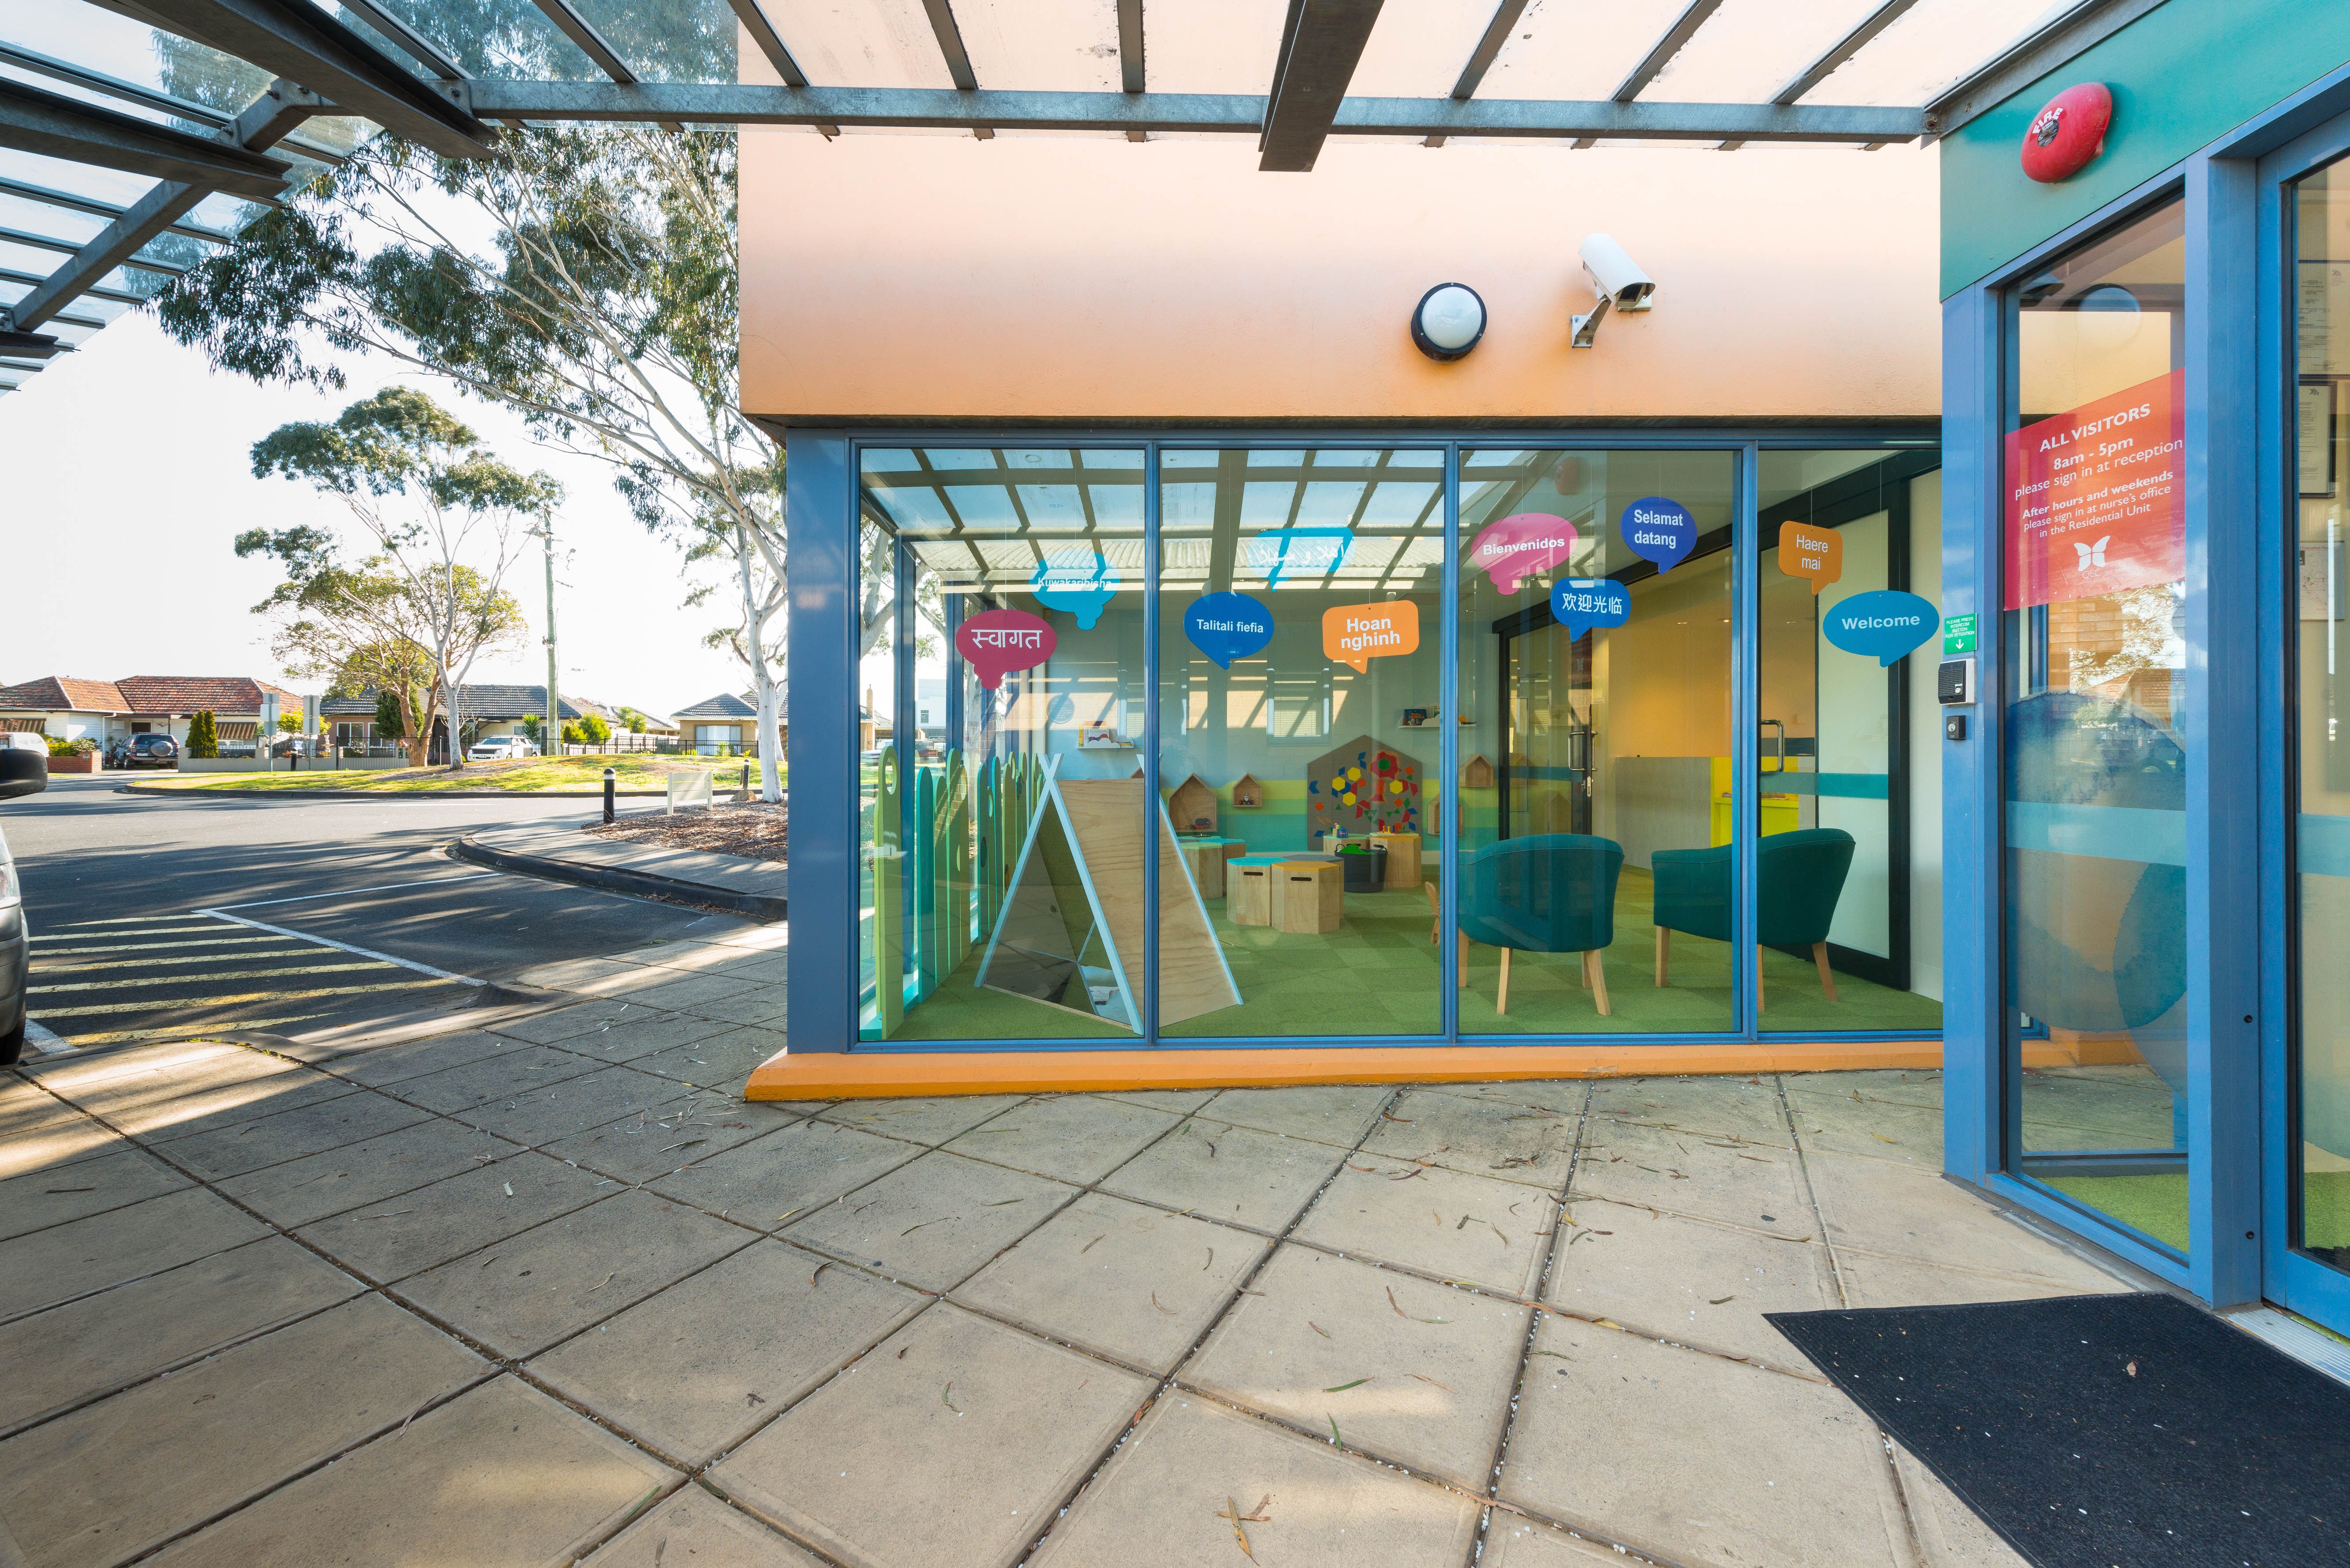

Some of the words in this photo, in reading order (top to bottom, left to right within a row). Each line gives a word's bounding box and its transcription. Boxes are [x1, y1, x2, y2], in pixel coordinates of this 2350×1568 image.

[2032, 107, 2063, 134] FIRE
[2040, 434, 2069, 452] ALL
[2071, 403, 2151, 440] VISITORS
[2054, 454, 2084, 469] 8am
[2100, 439, 2133, 458] 5pm
[2015, 480, 2050, 500] please
[2054, 472, 2077, 486] sign
[2082, 467, 2092, 477] in
[2097, 462, 2109, 473] at
[2115, 439, 2182, 467] reception
[2022, 506, 2049, 519] After
[2053, 497, 2083, 510] hours
[2087, 487, 2108, 500] and
[2111, 470, 2173, 494] weekends
[1634, 509, 1683, 526] Selamat
[2024, 518, 2051, 532] please
[2054, 512, 2071, 523] sign
[2100, 494, 2135, 510] nurse's
[2140, 486, 2171, 500] office
[2050, 525, 2065, 534] the
[2069, 510, 2123, 530] Residential
[2127, 504, 2151, 516] Unit
[1483, 538, 1565, 555] Bienvenidos
[1634, 530, 1676, 549] datang
[1796, 534, 1828, 553] Haere
[1802, 557, 1821, 570] mai
[1562, 593, 1622, 615] 欢迎光临
[1196, 619, 1233, 631] Talitali
[1237, 622, 1263, 633] fiefia
[1347, 618, 1391, 631] Hoan
[1842, 616, 1920, 630] Welcome
[971, 629, 1043, 649] स्वागत
[1341, 631, 1400, 650] nghinh
